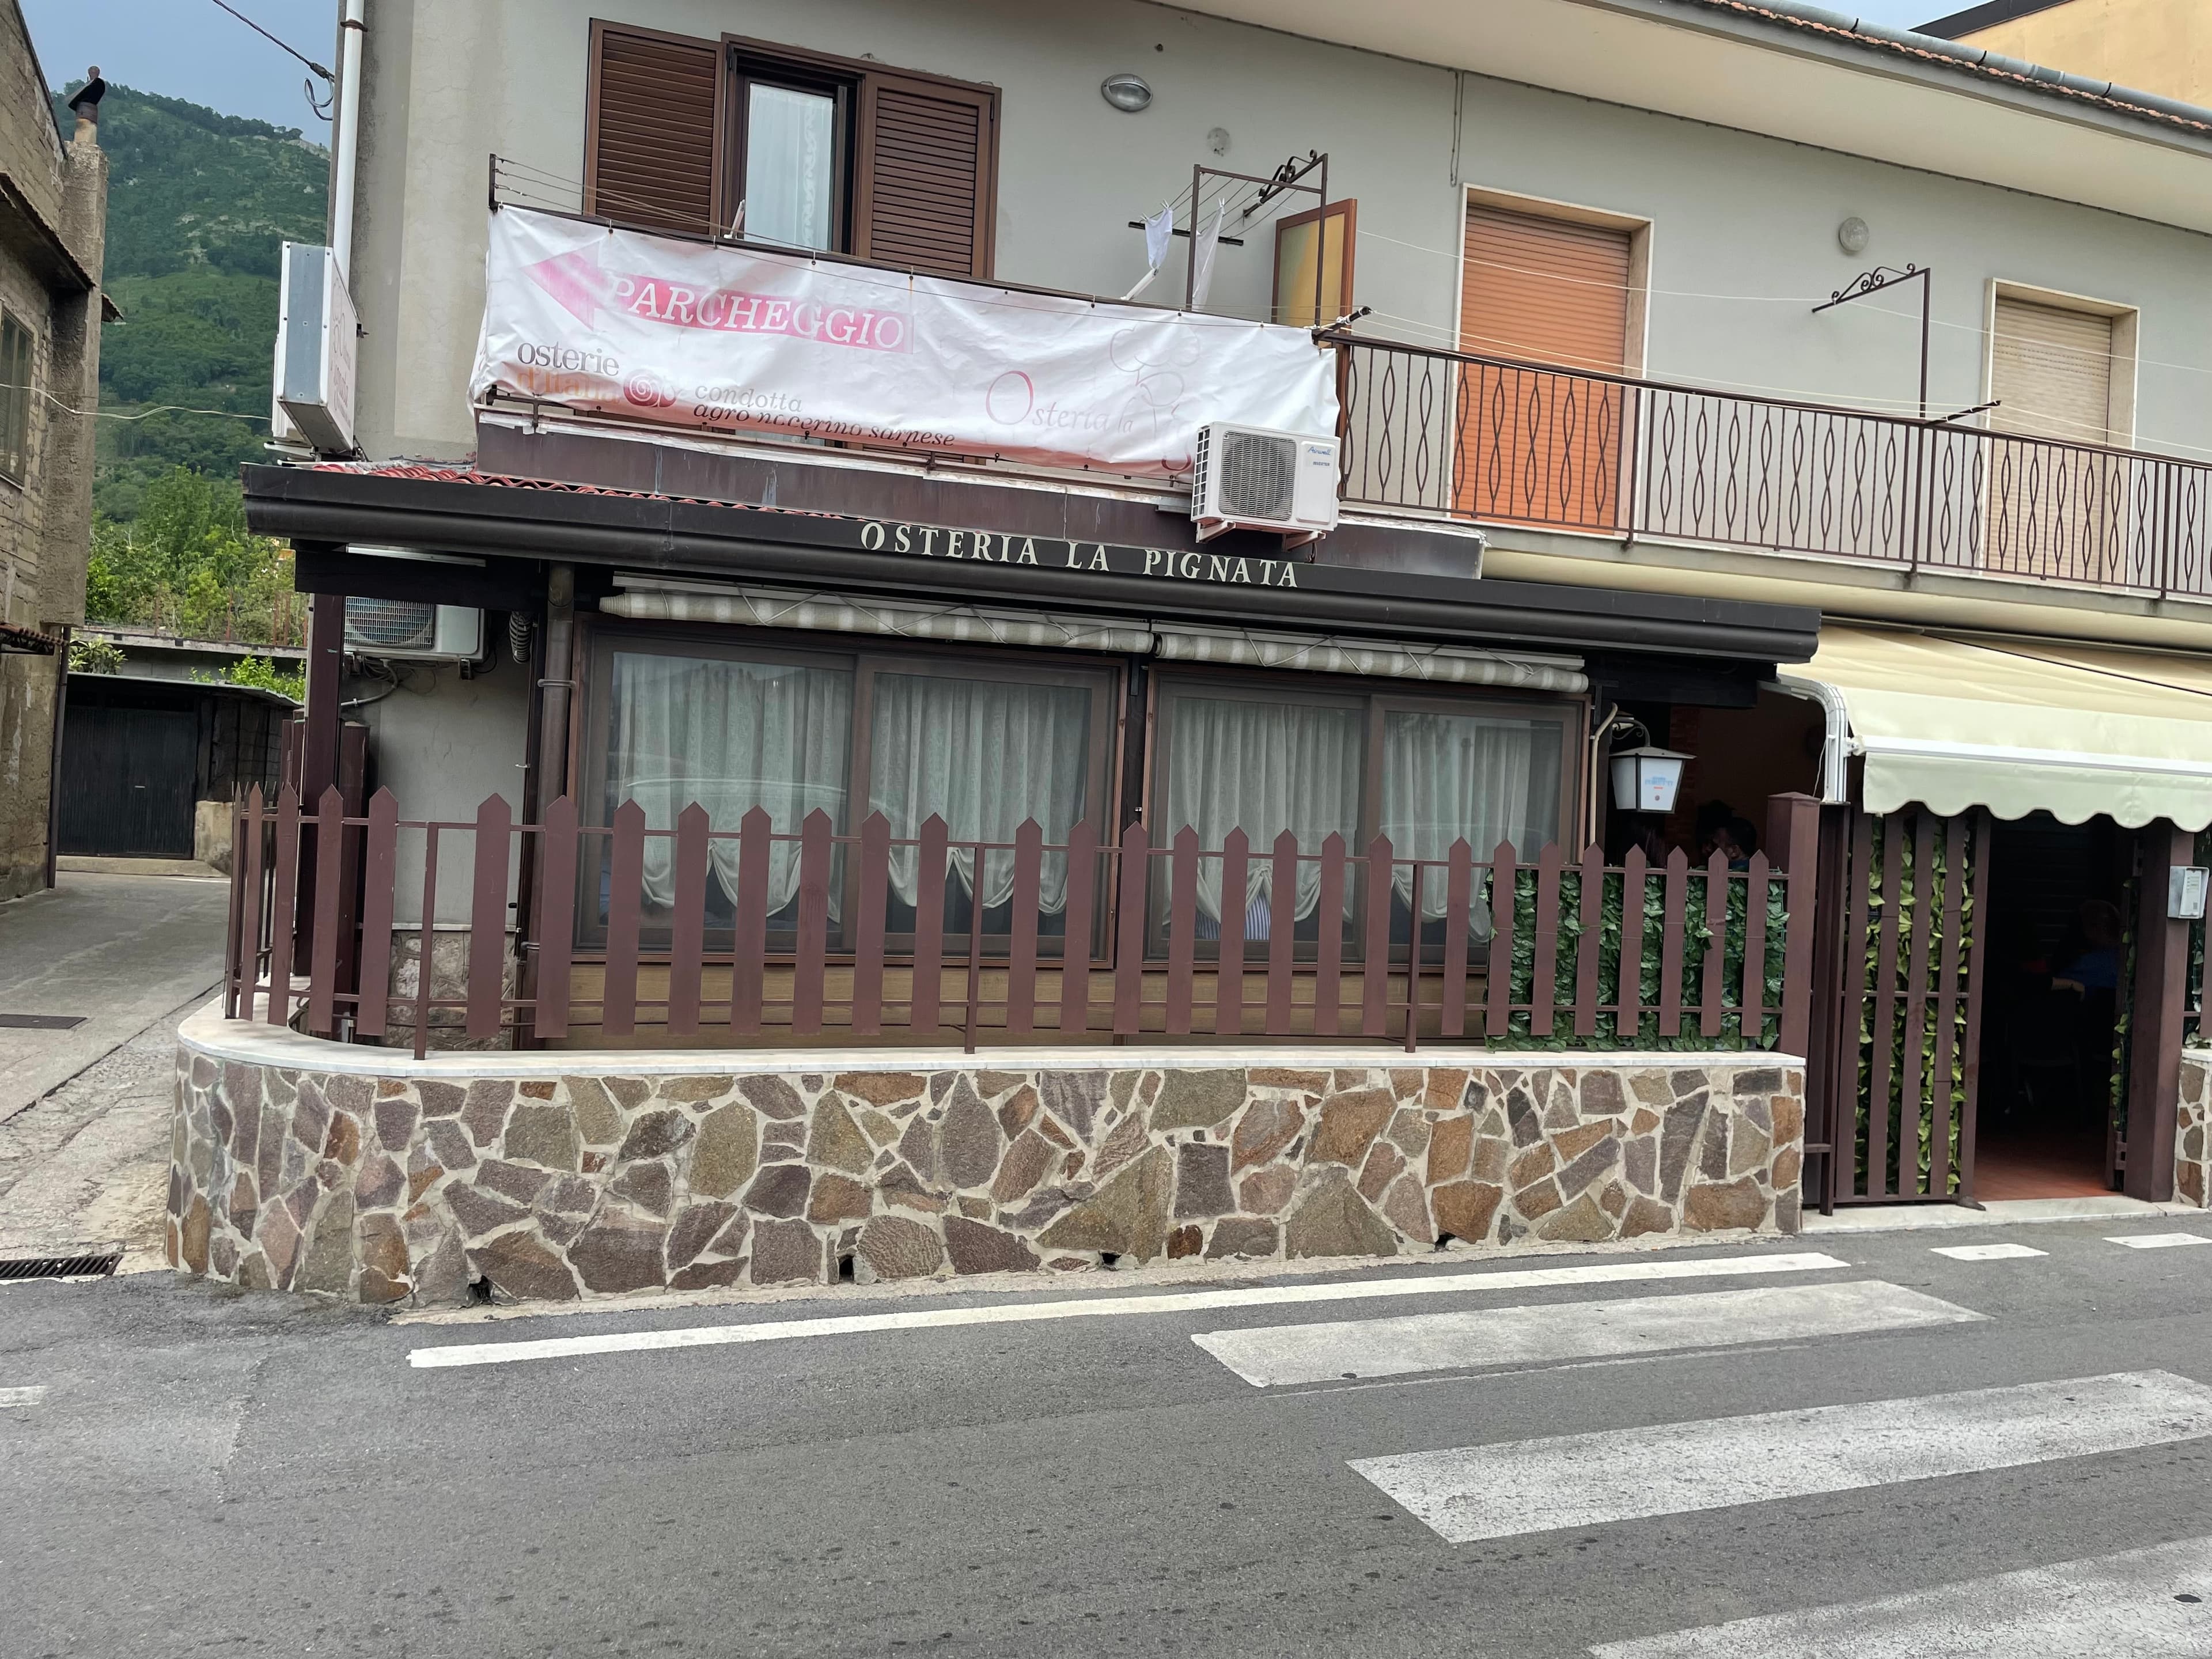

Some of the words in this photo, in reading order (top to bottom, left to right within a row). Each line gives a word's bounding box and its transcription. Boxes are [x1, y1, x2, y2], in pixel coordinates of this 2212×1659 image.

[611, 276, 905, 349] PARCHEGGIO
[518, 341, 620, 376] osterie
[695, 385, 802, 412] condotta
[985, 370, 1111, 430] Osteria
[693, 404, 749, 422] agro
[869, 425, 956, 446] sarnese
[861, 522, 1038, 565] OSTERIA
[1065, 542, 1109, 571] LA
[1142, 550, 1298, 588] PIGNATA
